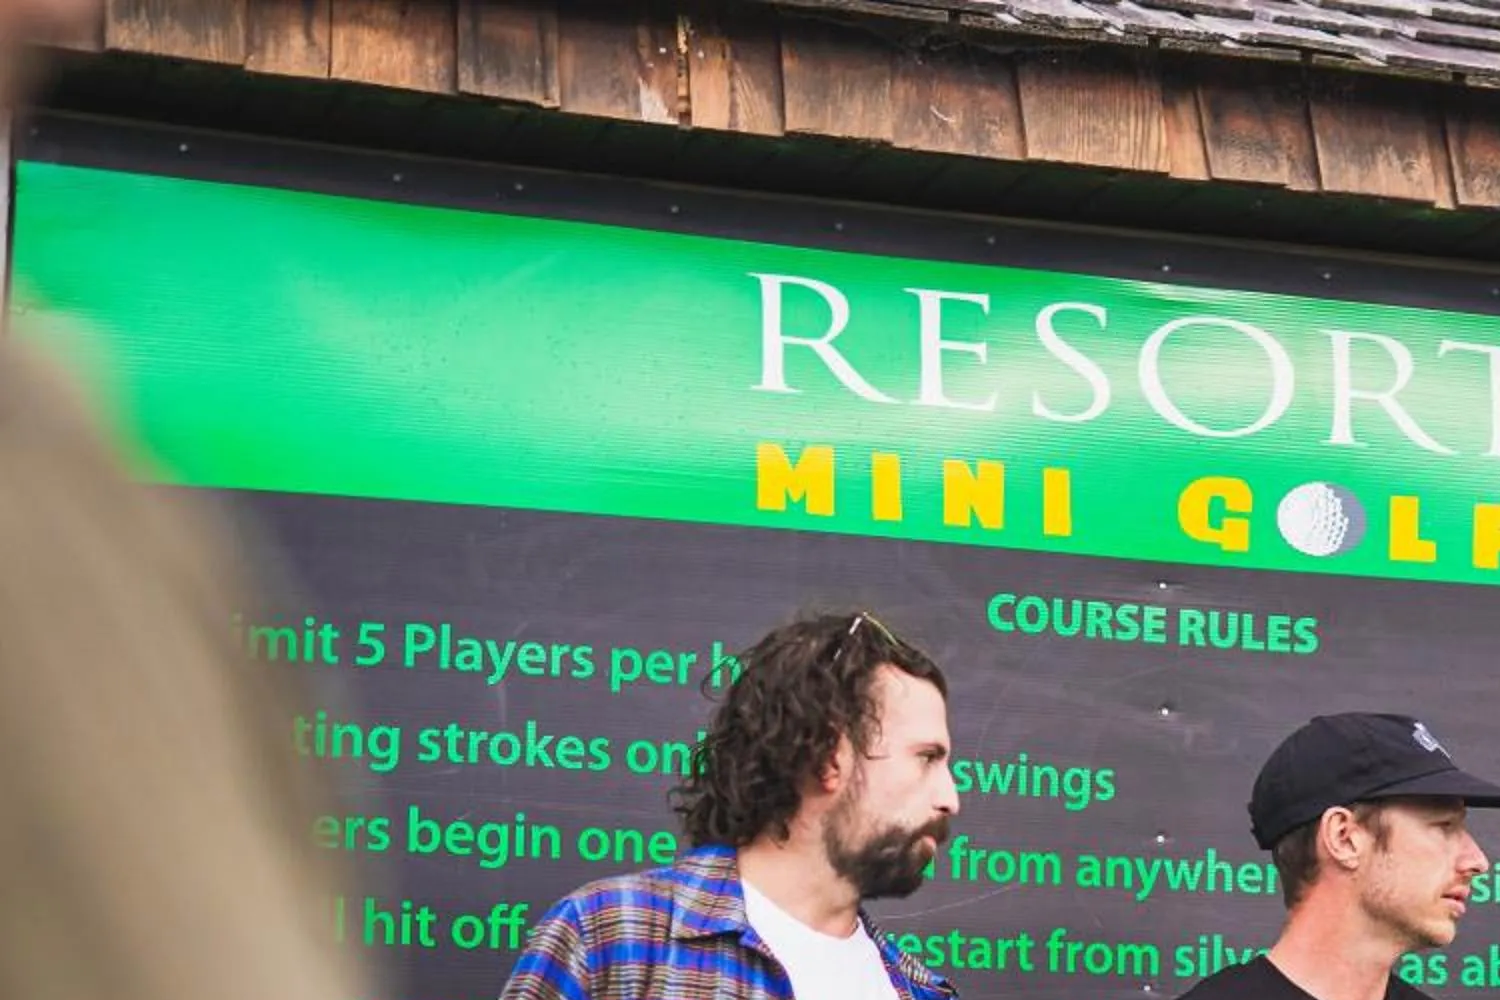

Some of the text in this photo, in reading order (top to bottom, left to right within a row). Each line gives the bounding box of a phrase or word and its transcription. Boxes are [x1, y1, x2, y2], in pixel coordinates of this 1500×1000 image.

[755, 443, 1073, 536] MINI
[355, 621, 386, 667] 5
[403, 621, 595, 685] Players
[610, 647, 697, 693] per
[986, 592, 1320, 655] COURSE RULES
[293, 709, 402, 773] ting
[417, 721, 612, 772] strokes
[951, 752, 1117, 811] swings
[407, 804, 563, 869] begin
[577, 826, 678, 864] one
[948, 834, 1064, 884] from
[1076, 847, 1279, 903] anywher
[362, 896, 437, 949] hit
[1045, 927, 1163, 978] from
[1399, 951, 1450, 987] as
